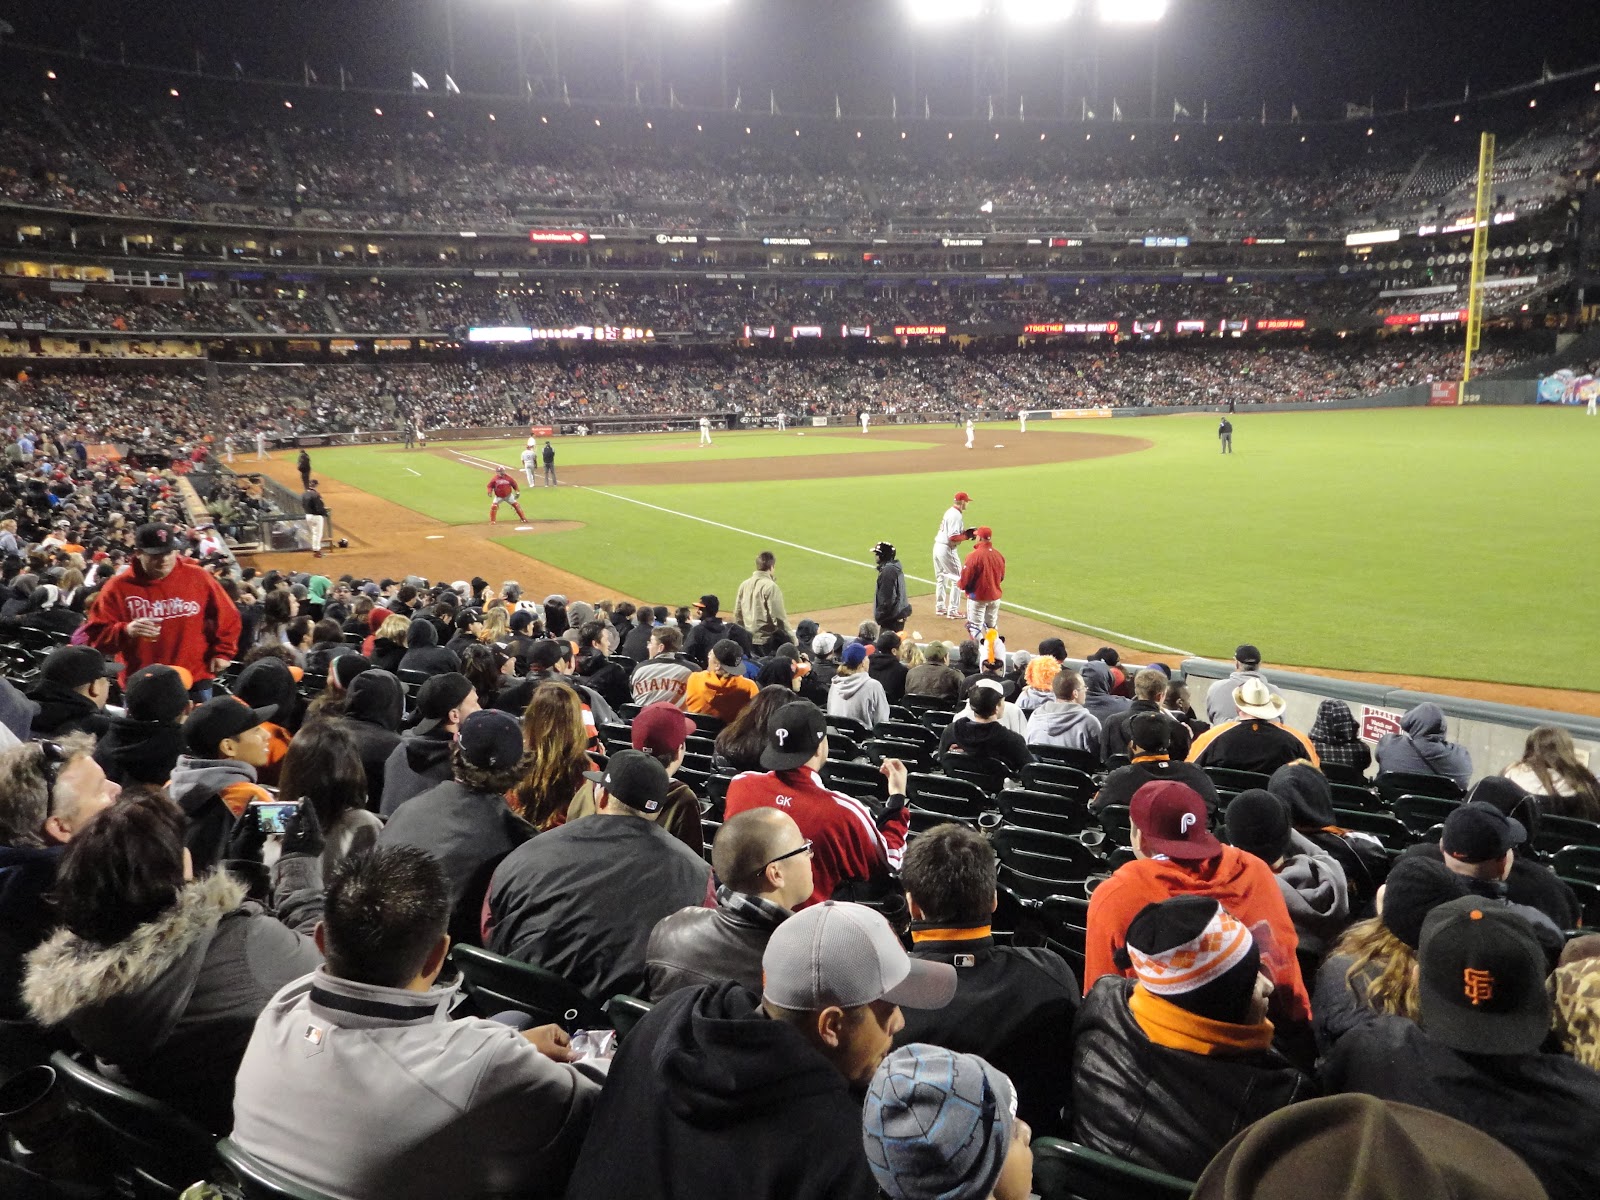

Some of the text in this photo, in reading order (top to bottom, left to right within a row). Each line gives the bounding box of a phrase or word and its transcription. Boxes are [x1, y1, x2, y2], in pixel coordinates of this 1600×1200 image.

[635, 677, 688, 696] GIANTS
[775, 728, 789, 747] P
[775, 794, 793, 807] GK
